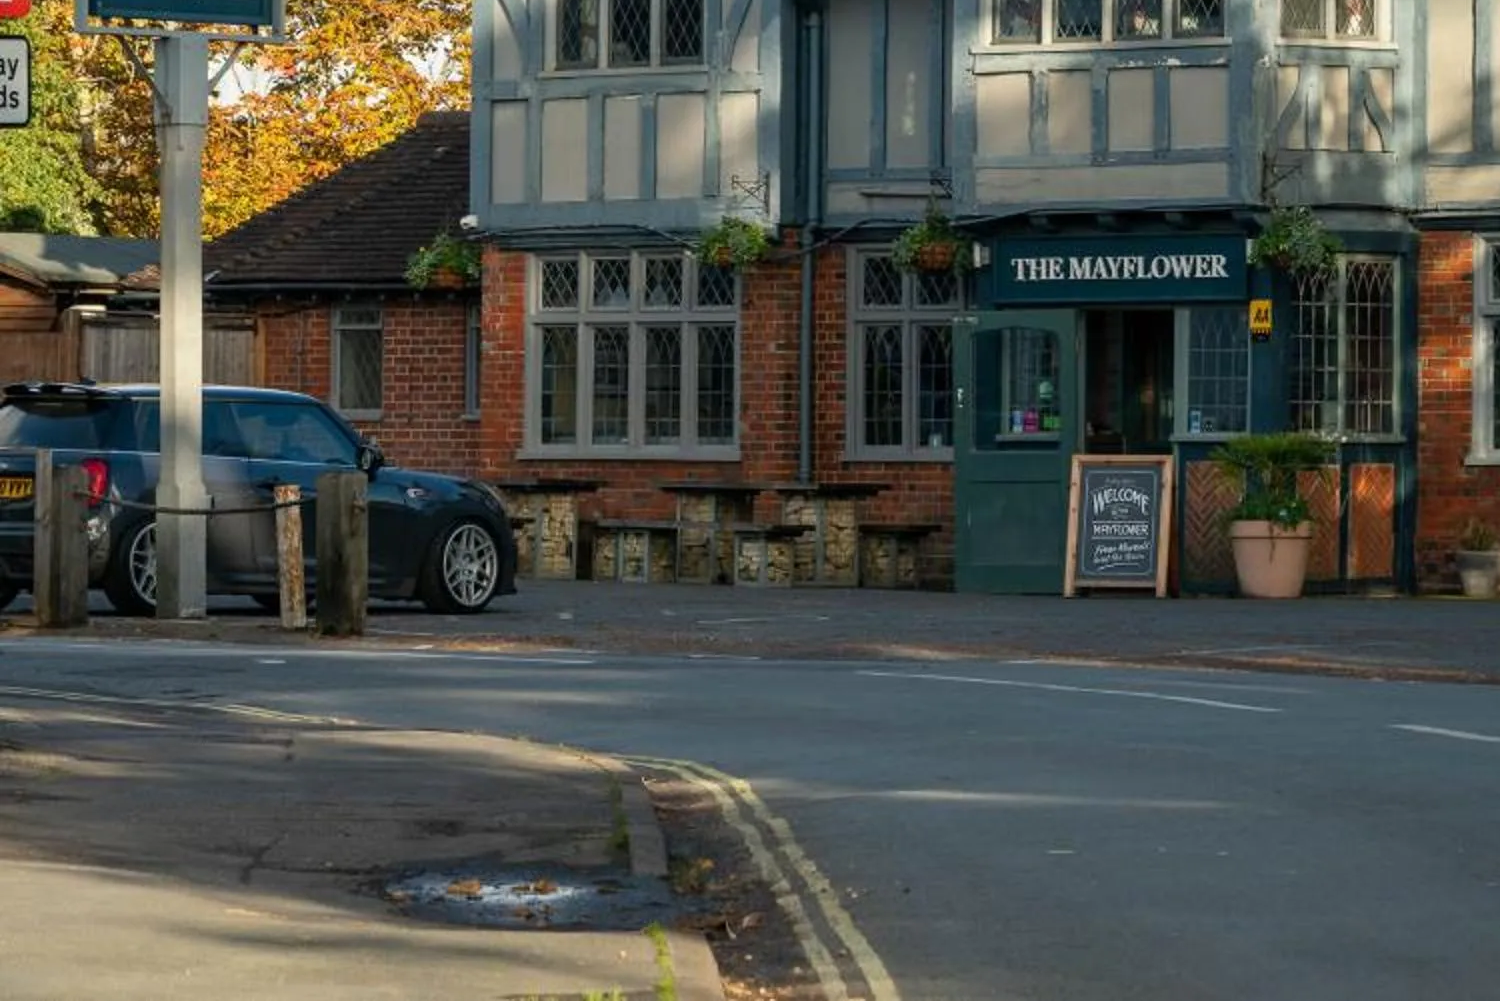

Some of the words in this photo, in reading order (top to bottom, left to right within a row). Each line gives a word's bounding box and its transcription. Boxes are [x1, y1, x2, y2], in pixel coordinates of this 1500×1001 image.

[1011, 257, 1064, 282] THE
[1068, 254, 1229, 280] MAYFLOWER
[1253, 307, 1269, 324] AA
[1093, 488, 1150, 516] WELCOME
